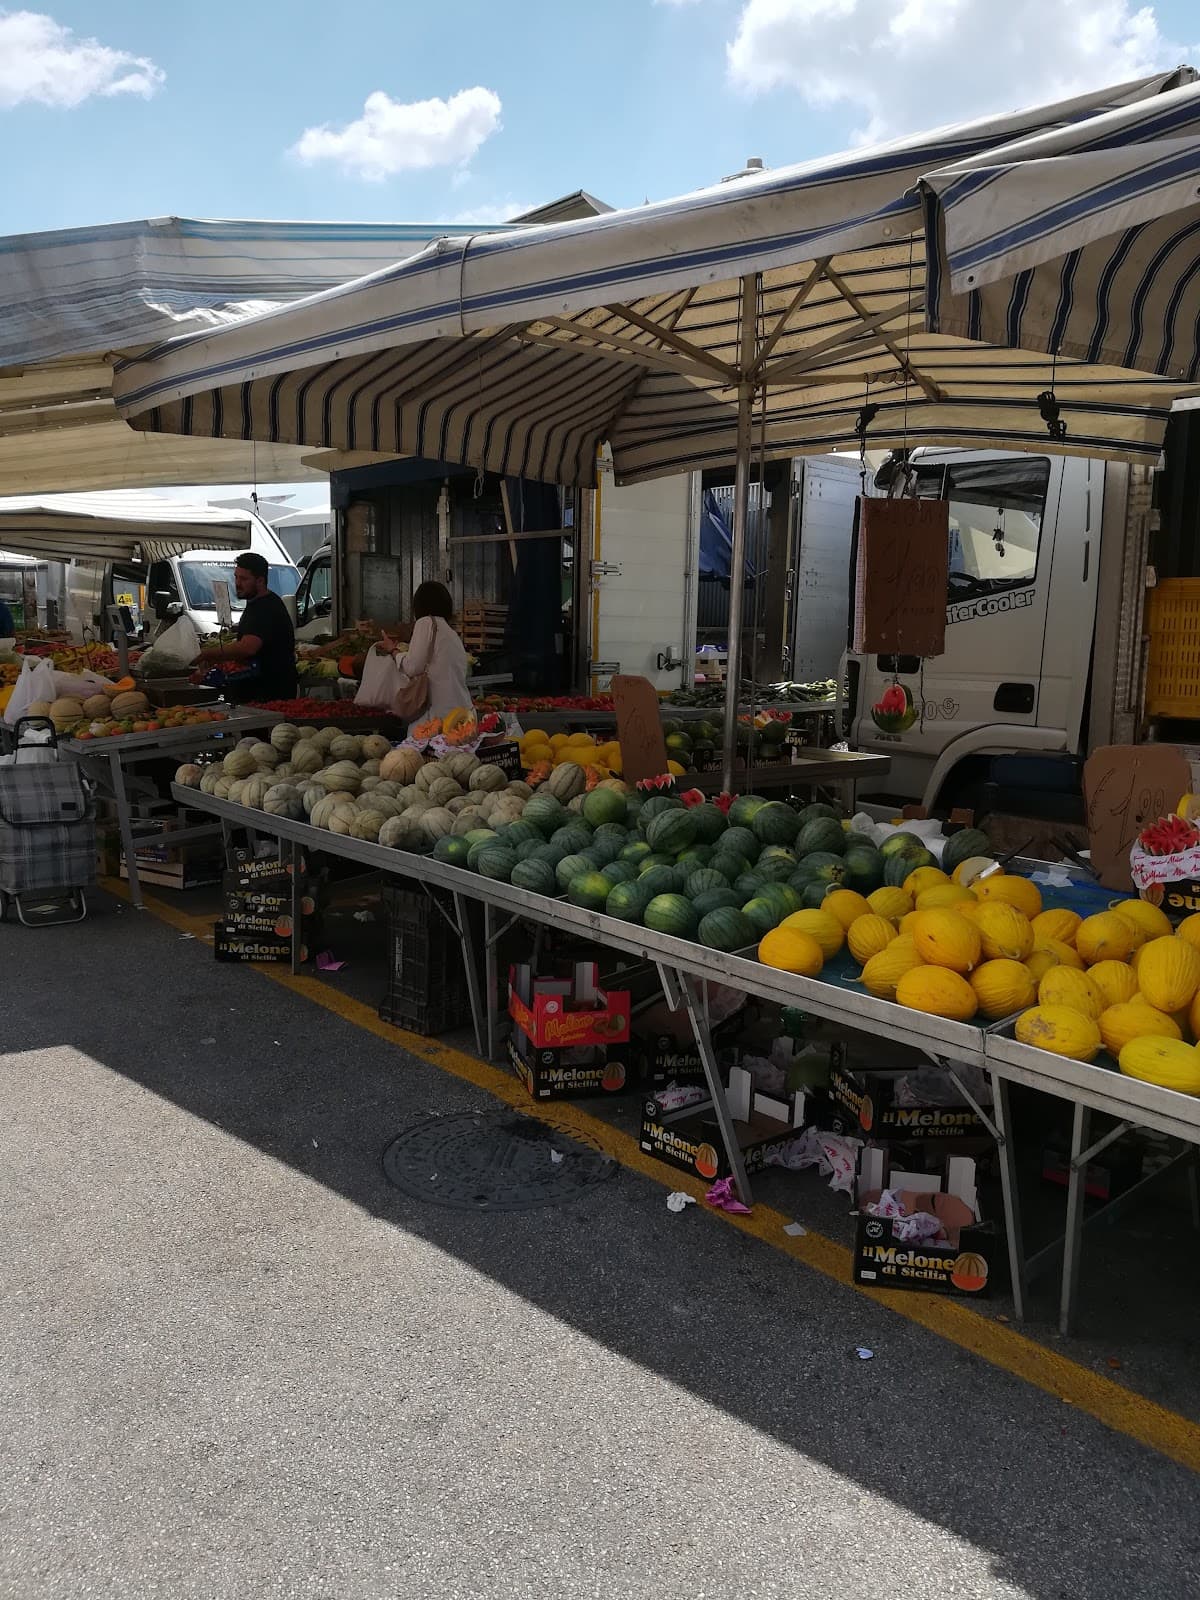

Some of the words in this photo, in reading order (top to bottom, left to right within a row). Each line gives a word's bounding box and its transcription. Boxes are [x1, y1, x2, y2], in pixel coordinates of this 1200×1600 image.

[228, 943, 291, 955] Melone
[548, 1066, 604, 1082] Melone
[565, 1079, 600, 1090] Sicilia
[882, 1110, 894, 1124] il
[650, 1122, 700, 1156] Melone
[926, 1126, 966, 1137] Sicilia
[664, 1145, 695, 1165] Sicilia
[862, 1245, 874, 1258] il
[873, 1245, 956, 1272] Melone
[881, 1264, 897, 1277] di
[899, 1264, 948, 1281] Sicilia
